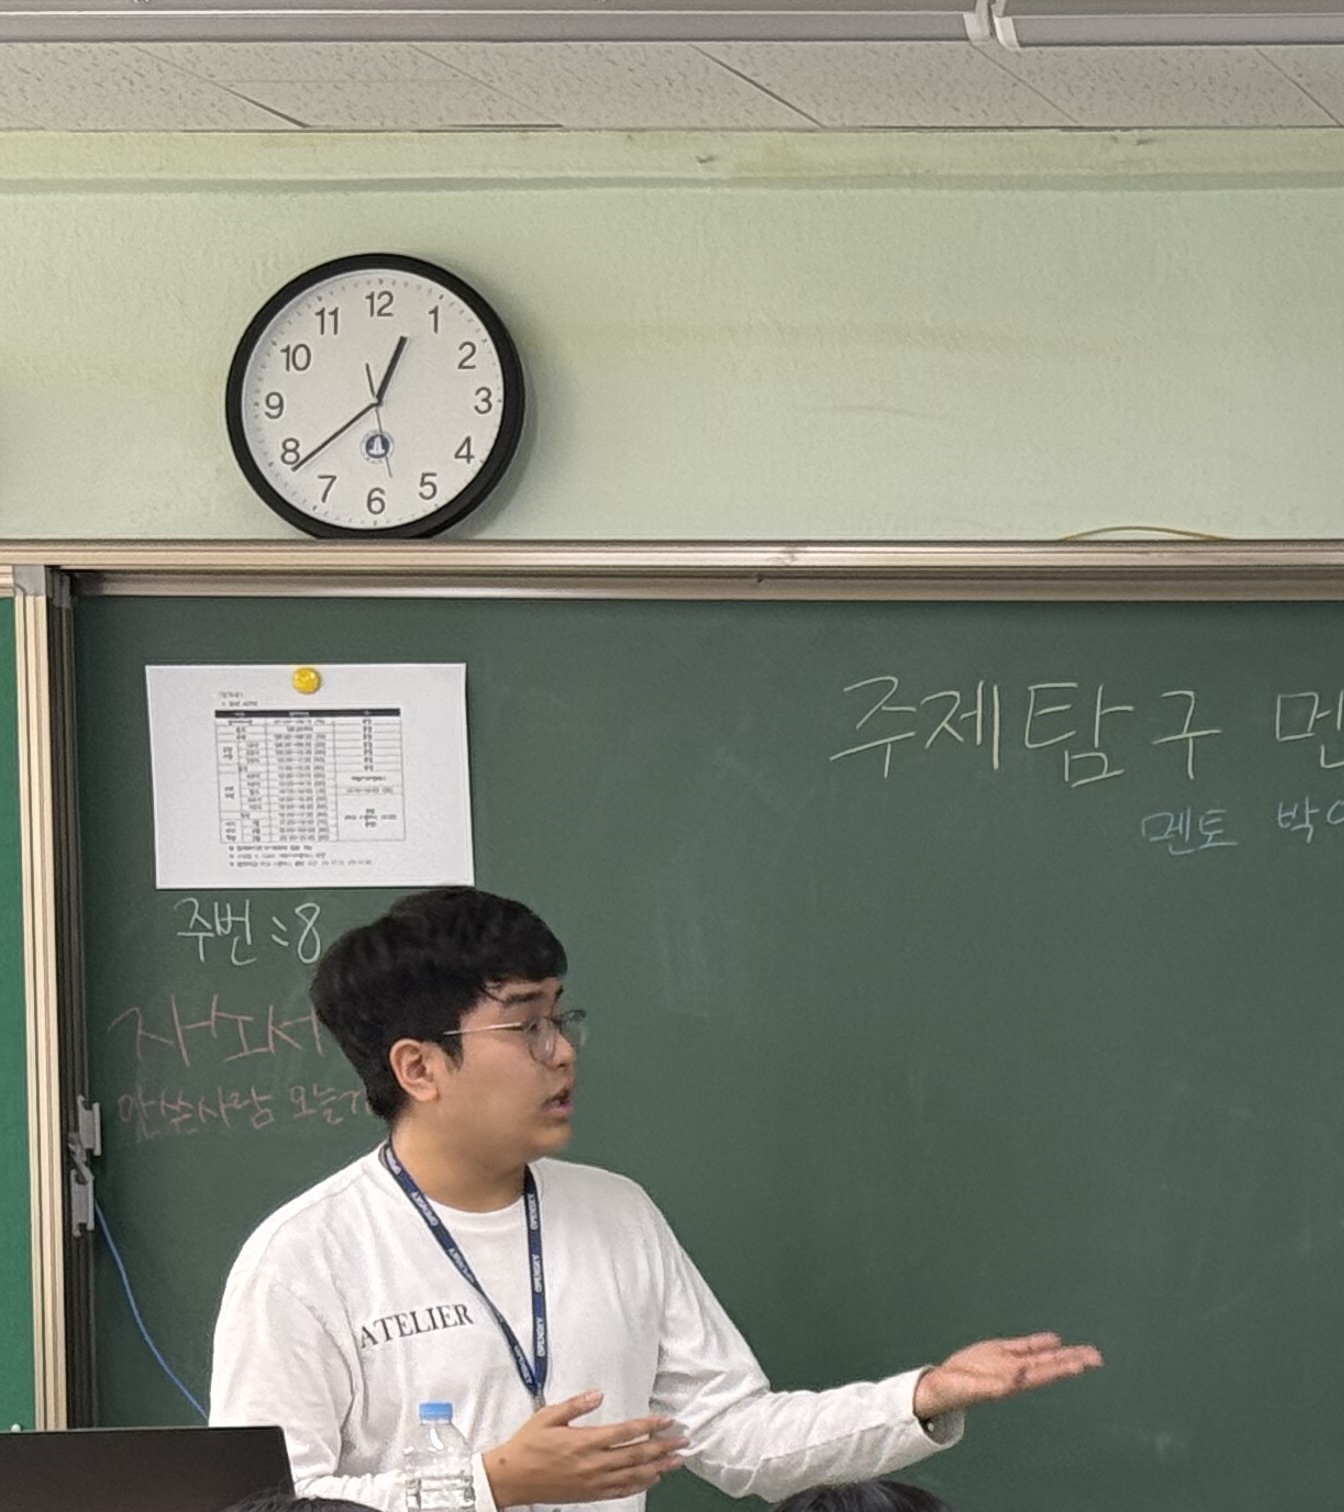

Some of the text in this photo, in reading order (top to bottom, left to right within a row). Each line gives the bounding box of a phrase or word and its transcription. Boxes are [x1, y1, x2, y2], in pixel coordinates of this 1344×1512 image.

[365, 290, 395, 318] 12
[314, 307, 339, 335] 11
[428, 305, 439, 334] 1
[280, 343, 312, 372] 10
[458, 341, 477, 370] 2
[264, 391, 284, 419] 9
[474, 386, 493, 414] 3
[280, 437, 301, 465] 8
[454, 436, 475, 465] 4
[317, 475, 337, 504] 7
[418, 472, 437, 500] 5
[366, 487, 386, 515] 6
[829, 674, 1224, 788] 주제탐구
[1140, 805, 1241, 856] 멘토
[359, 1302, 475, 1350] ATELIER
